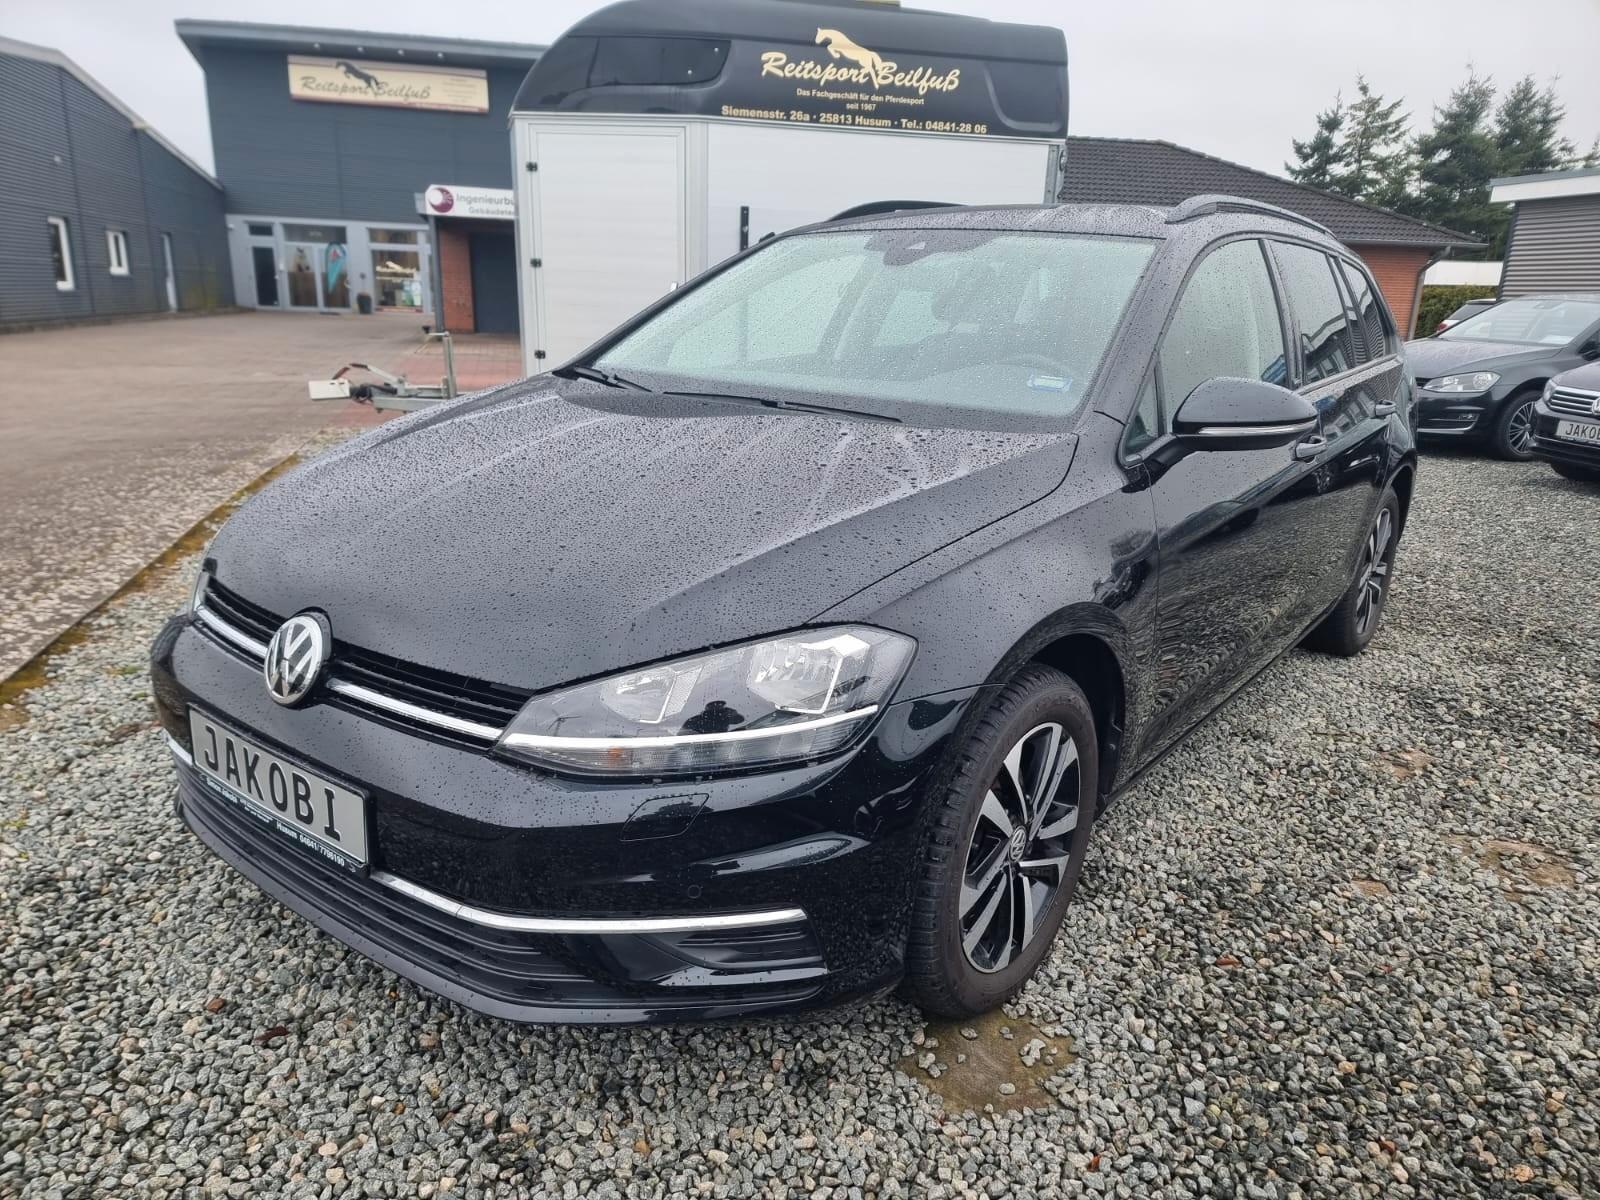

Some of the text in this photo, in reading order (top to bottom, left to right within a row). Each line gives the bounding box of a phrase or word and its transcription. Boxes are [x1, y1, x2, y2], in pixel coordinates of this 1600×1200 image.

[761, 51, 961, 94] Reitsport Beilfuß
[301, 76, 370, 96] Reitsport
[375, 82, 431, 101] Beilfuß
[796, 88, 924, 106] Das Fachgeschäft für den Pferdesport
[721, 105, 987, 133] Siemensstr. 26a 25813 Husum Tel.: 04841-28 06
[861, 103, 877, 111] 1967
[203, 725, 342, 842] JAKOBI
